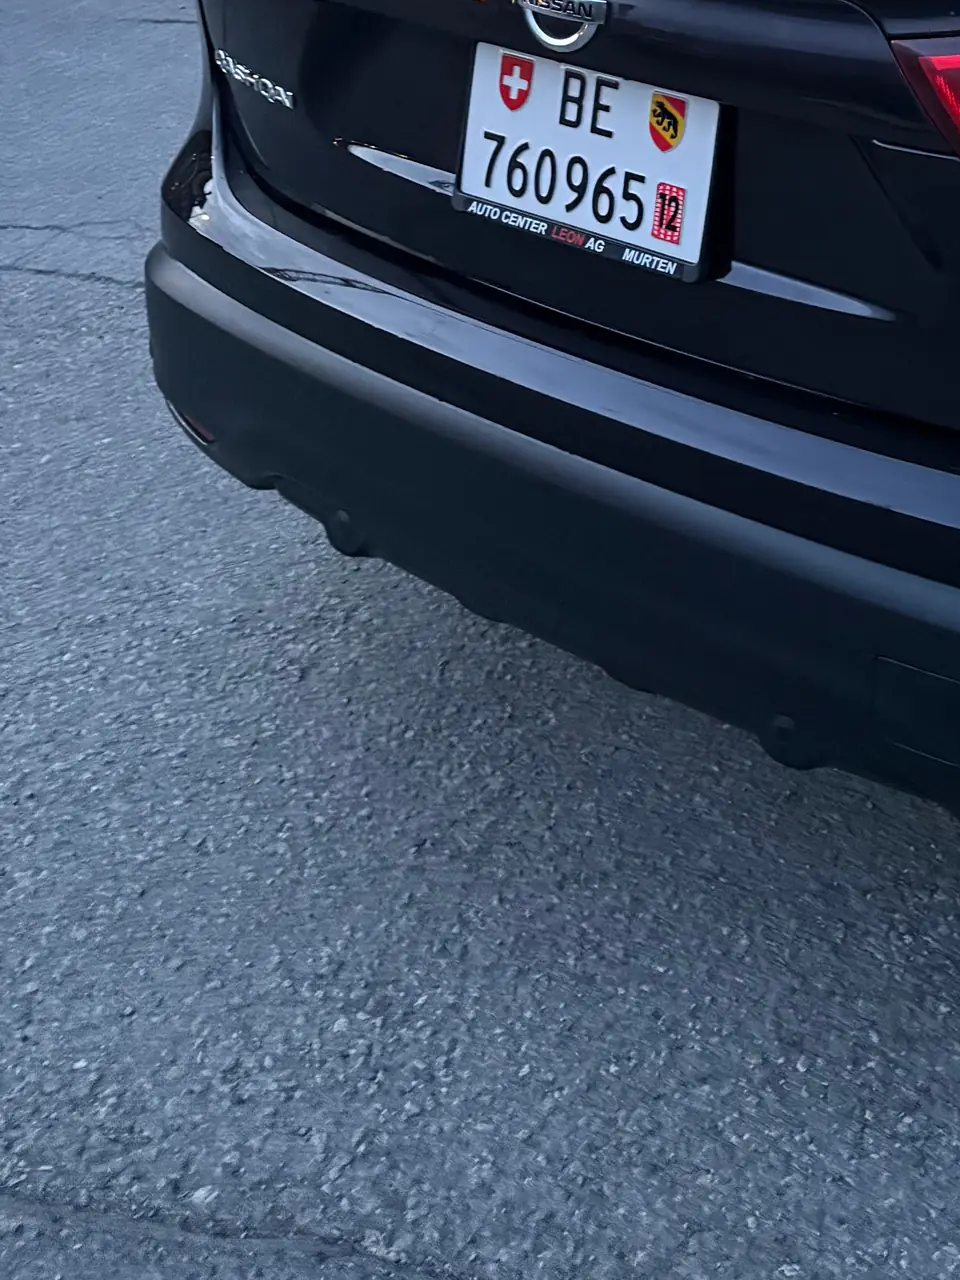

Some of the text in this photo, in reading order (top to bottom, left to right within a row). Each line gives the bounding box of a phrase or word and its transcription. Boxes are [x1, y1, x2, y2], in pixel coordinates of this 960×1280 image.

[558, 67, 620, 139] BE
[483, 130, 647, 232] 760965
[658, 191, 680, 233] 12
[467, 201, 678, 275] AUTO CENTER LEON AG MURTEN
